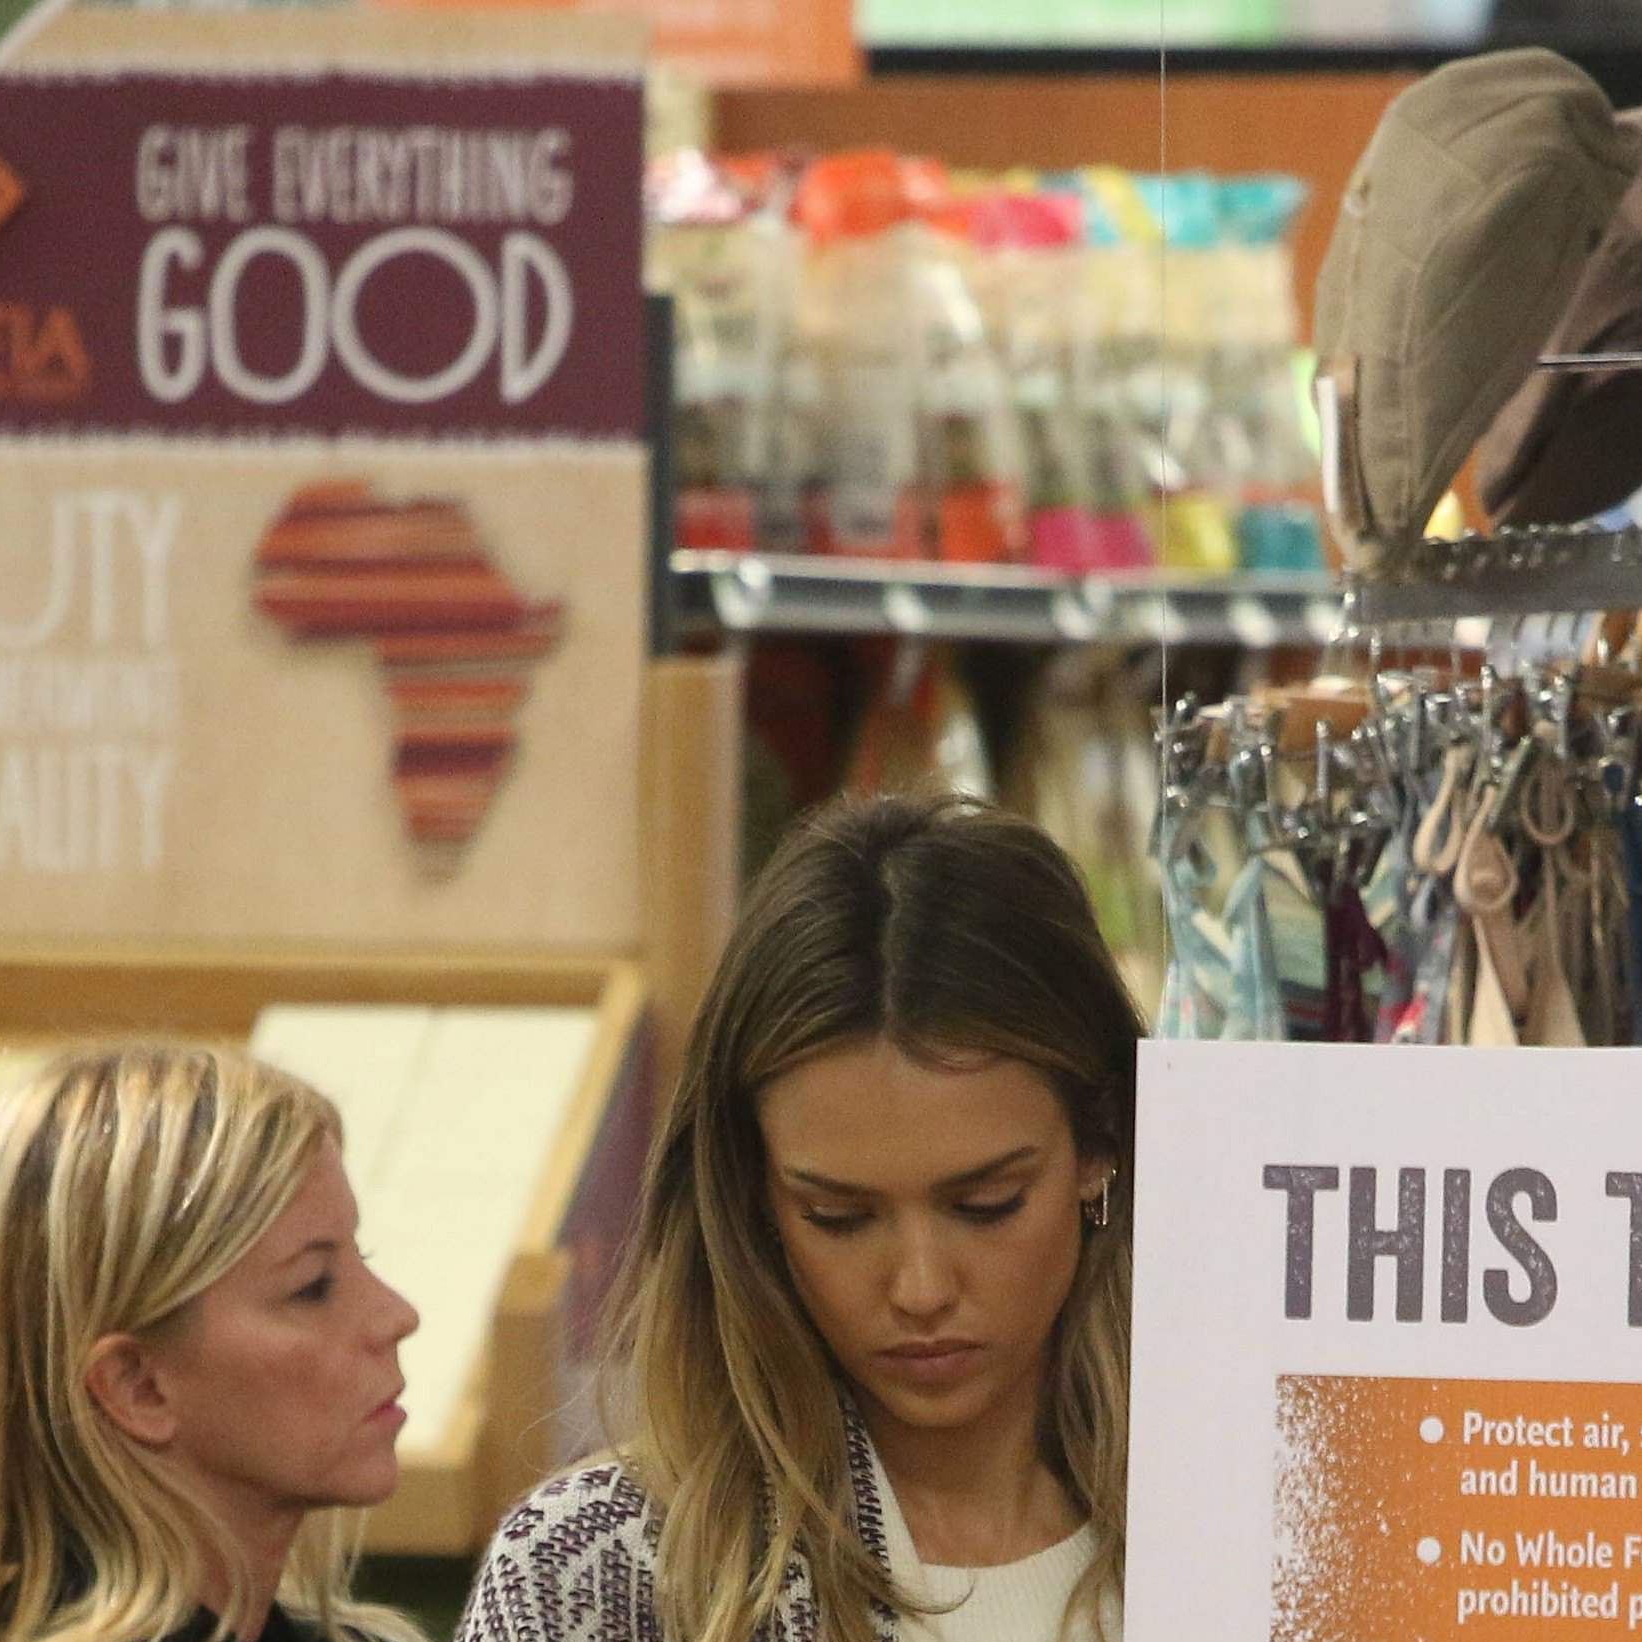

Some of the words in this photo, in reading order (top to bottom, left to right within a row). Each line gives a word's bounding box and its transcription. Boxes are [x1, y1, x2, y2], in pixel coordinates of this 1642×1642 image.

[136, 124, 253, 223] GIVE
[273, 124, 575, 224] EVERYTHING
[136, 226, 575, 404] GOOD
[1262, 1163, 1558, 1327] THIS
[1462, 1410, 1574, 1448] Protect
[1583, 1412, 1630, 1456] air,
[1460, 1459, 1519, 1497] and
[1528, 1459, 1638, 1499] human
[1460, 1530, 1507, 1567] No
[1515, 1530, 1614, 1569] Whole
[1457, 1579, 1619, 1626] prohibited
